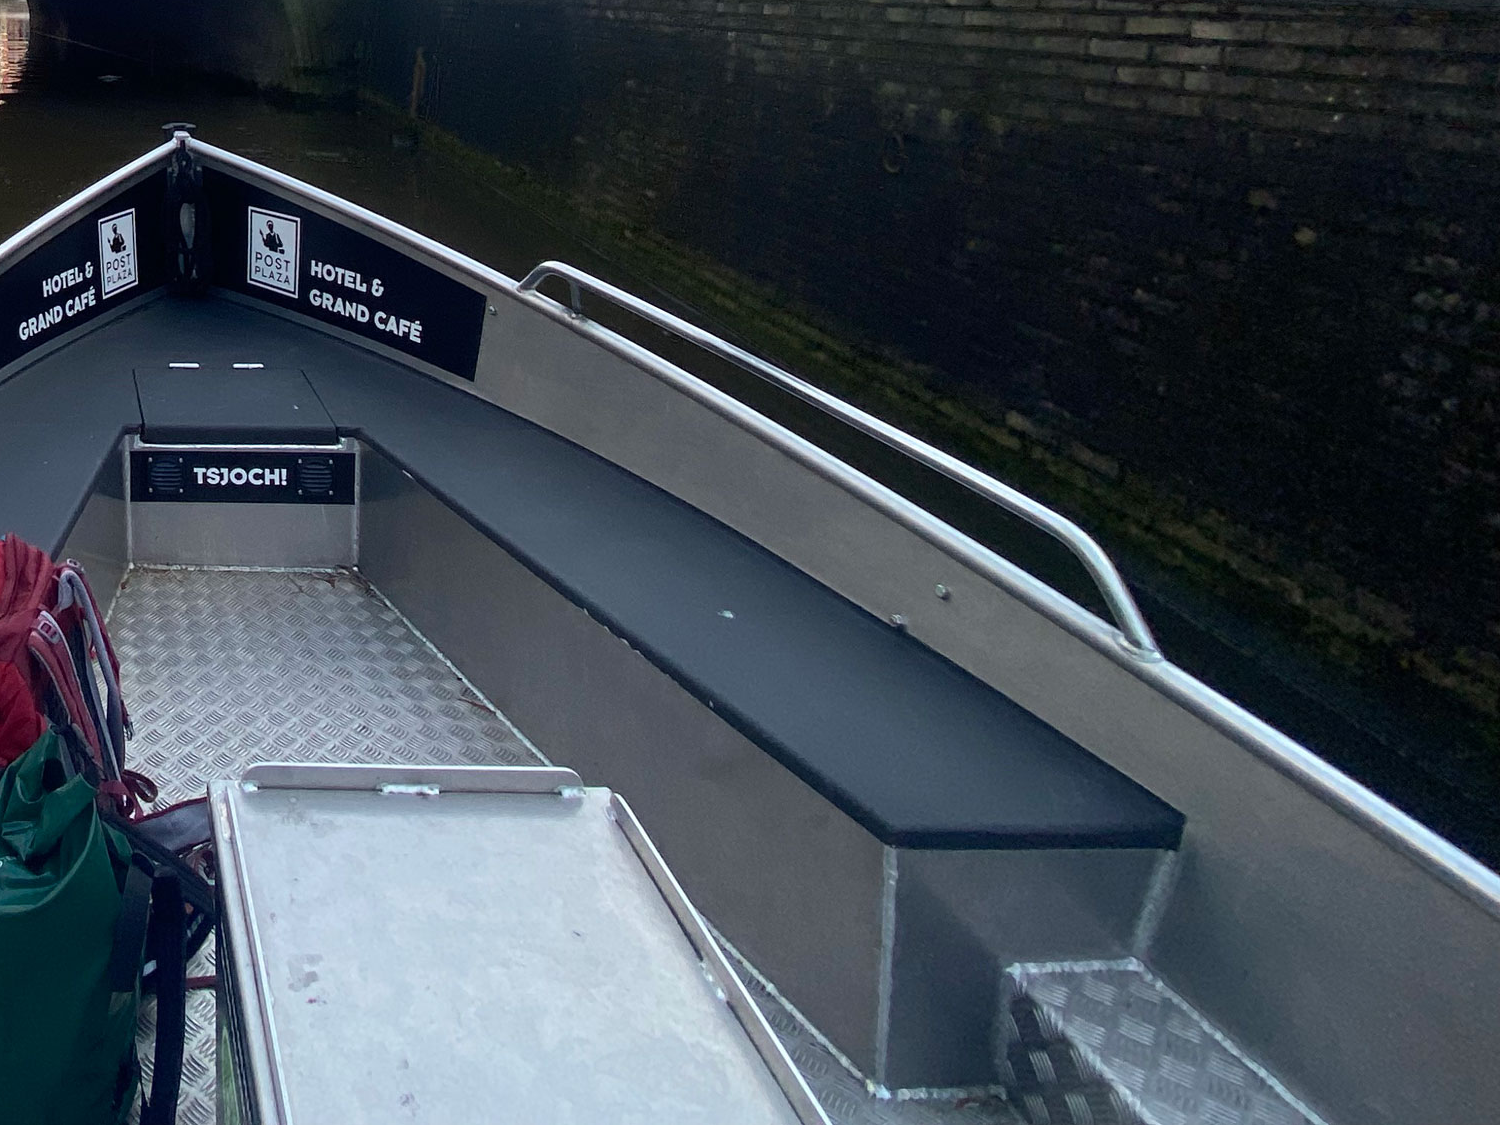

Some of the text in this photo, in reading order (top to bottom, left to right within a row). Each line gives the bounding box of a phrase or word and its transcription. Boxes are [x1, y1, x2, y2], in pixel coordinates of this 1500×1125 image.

[106, 253, 131, 273] POST
[255, 251, 291, 272] POST
[42, 261, 94, 297] HOTEL &
[107, 269, 132, 286] PLAZA
[254, 266, 291, 285] PLAZA
[310, 260, 384, 297] HOTEL &
[19, 286, 96, 341] GRAND CAFÉ
[309, 289, 423, 343] GRAND CAFÉ
[193, 467, 288, 486] TSJOCH!
